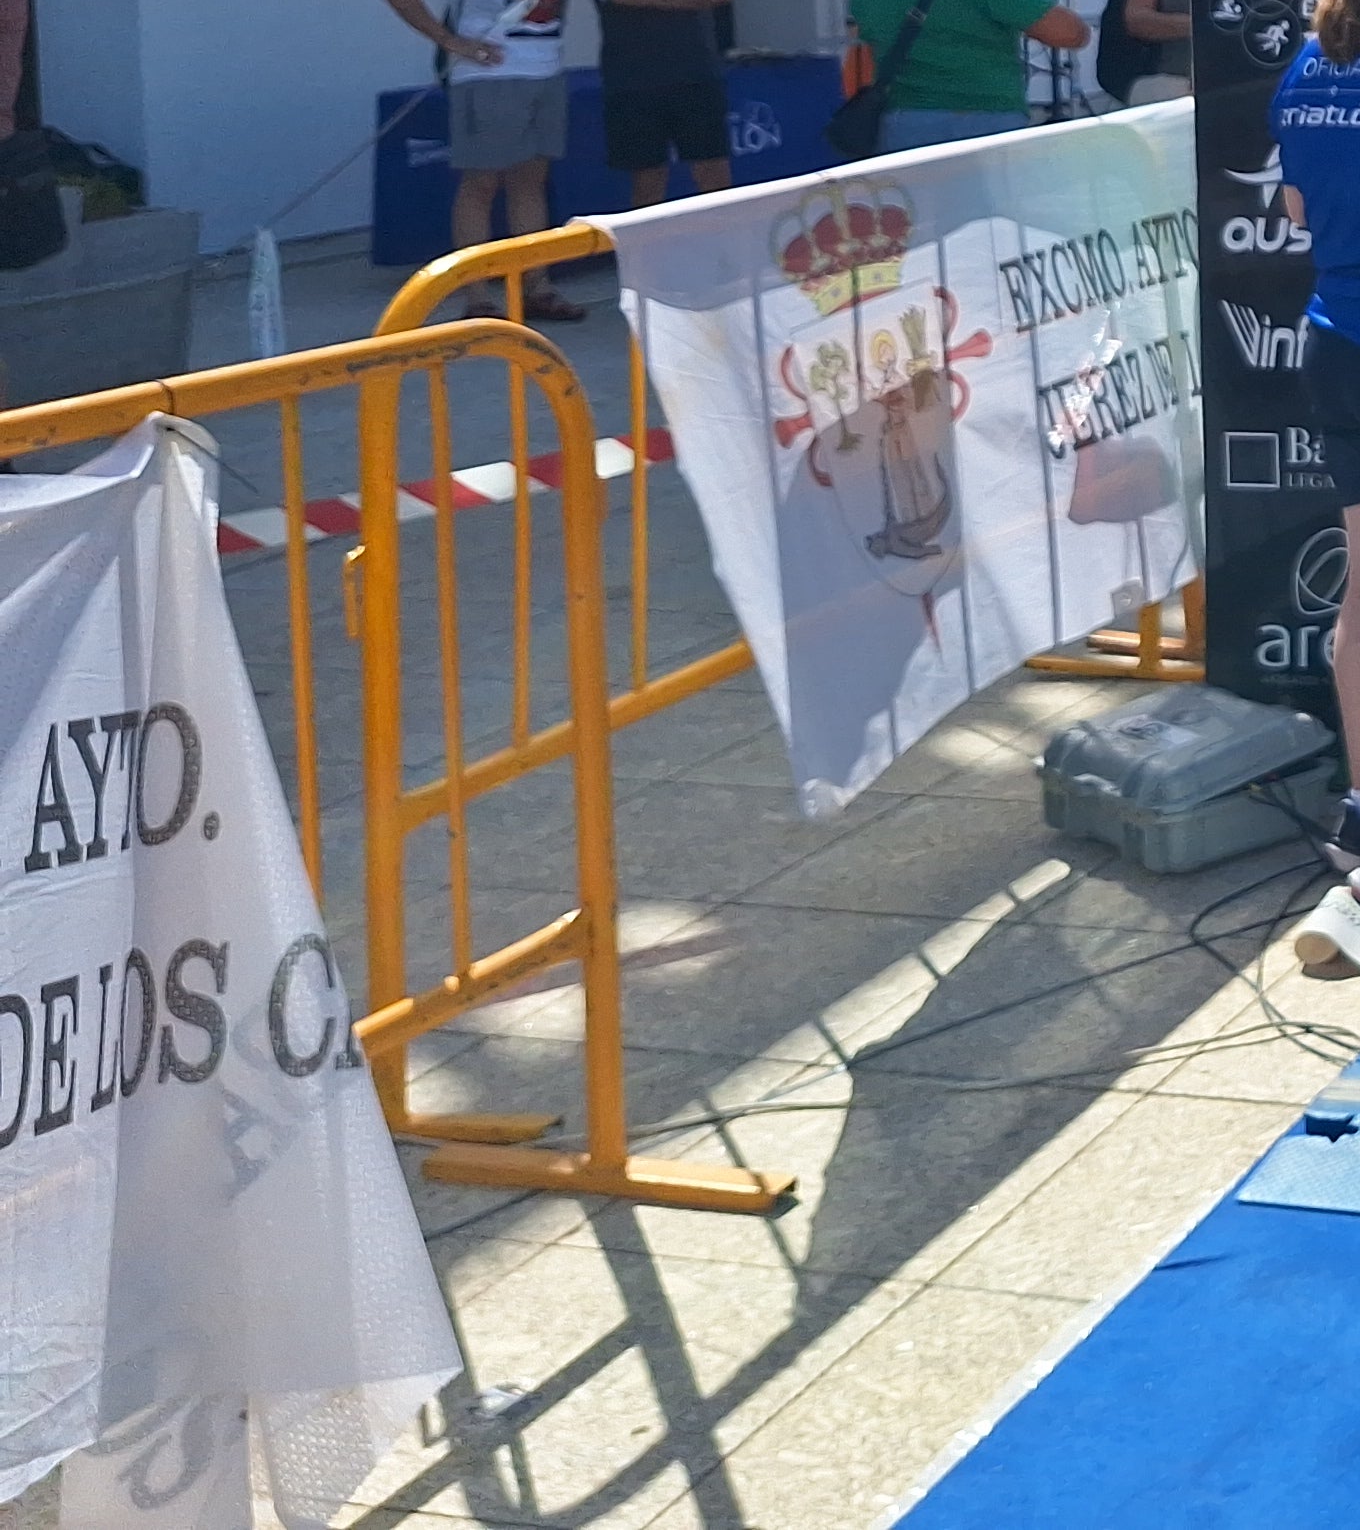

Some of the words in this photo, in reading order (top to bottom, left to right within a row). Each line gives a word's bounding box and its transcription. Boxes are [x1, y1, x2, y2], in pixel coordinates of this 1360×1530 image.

[999, 228, 1134, 333] EXCMO.
[23, 700, 221, 874] AYTO.
[90, 939, 230, 1113] LOS
